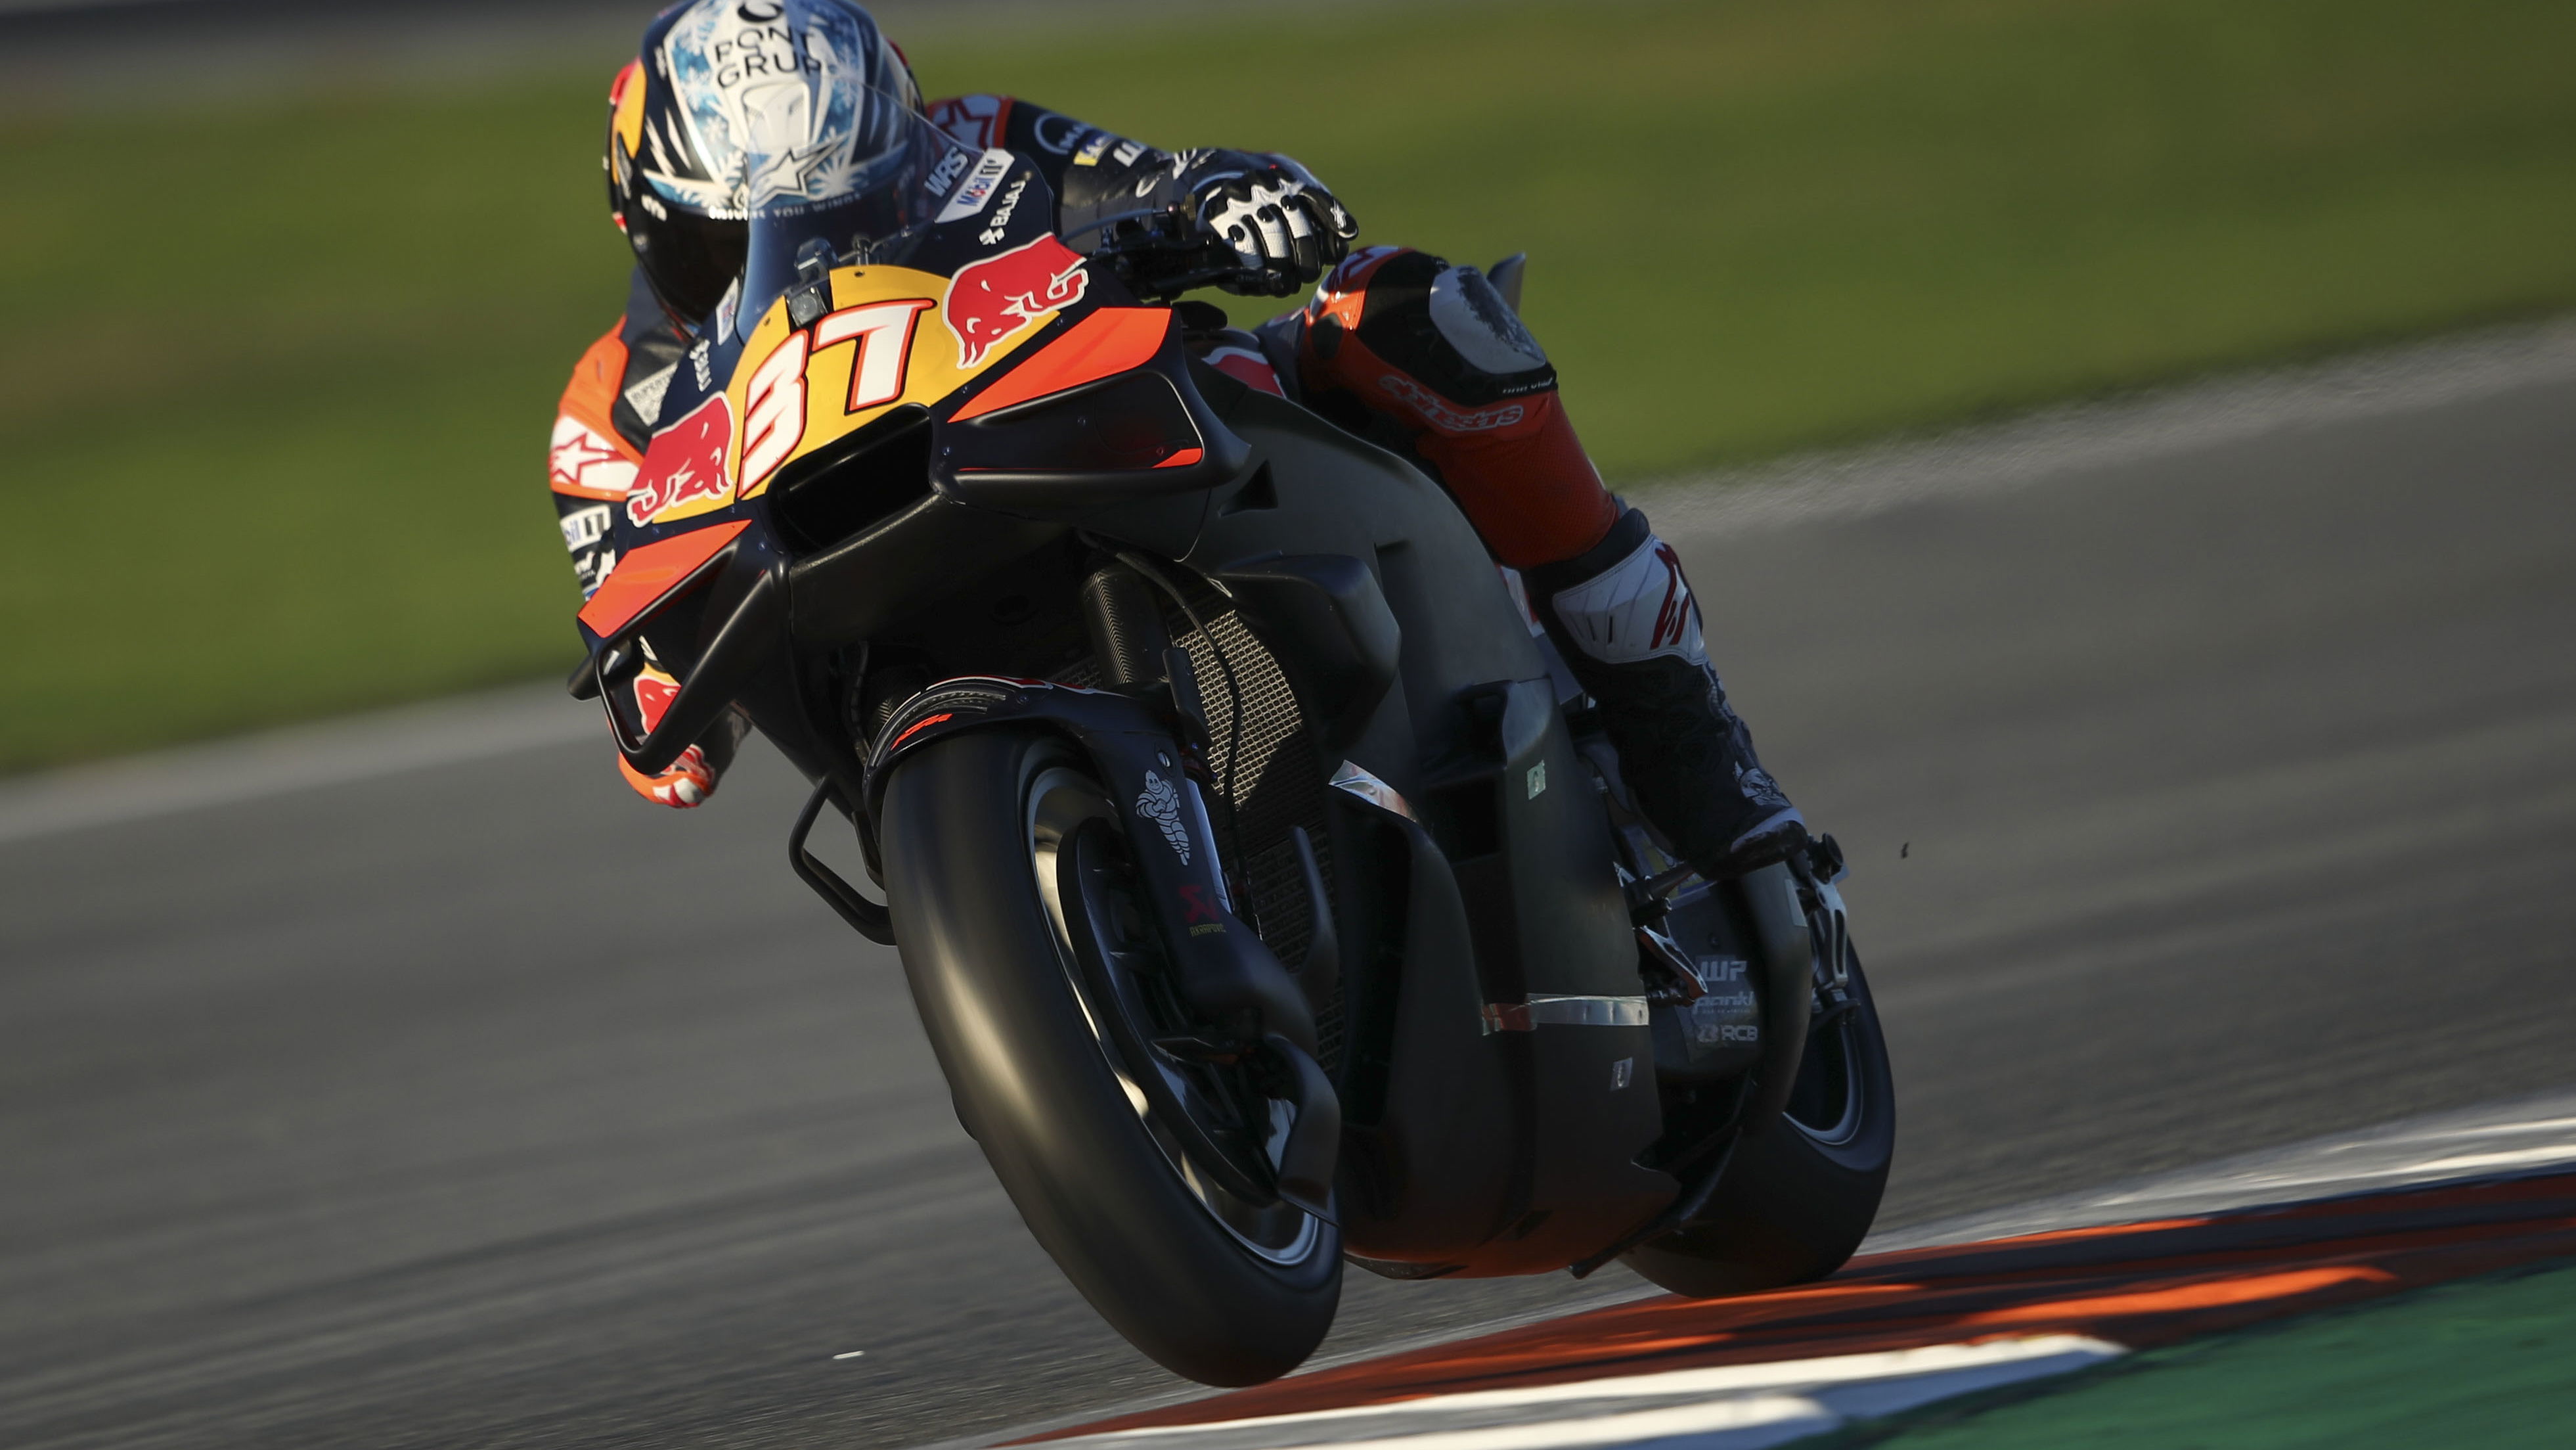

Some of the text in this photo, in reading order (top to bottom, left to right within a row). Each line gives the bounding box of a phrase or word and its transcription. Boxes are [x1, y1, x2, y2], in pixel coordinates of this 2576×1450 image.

[923, 147, 969, 198] WRS
[990, 179, 1026, 227] BAJAJ
[737, 298, 937, 499] 37
[1701, 961, 1748, 982] WP
[1721, 1025, 1758, 1041] RCB
